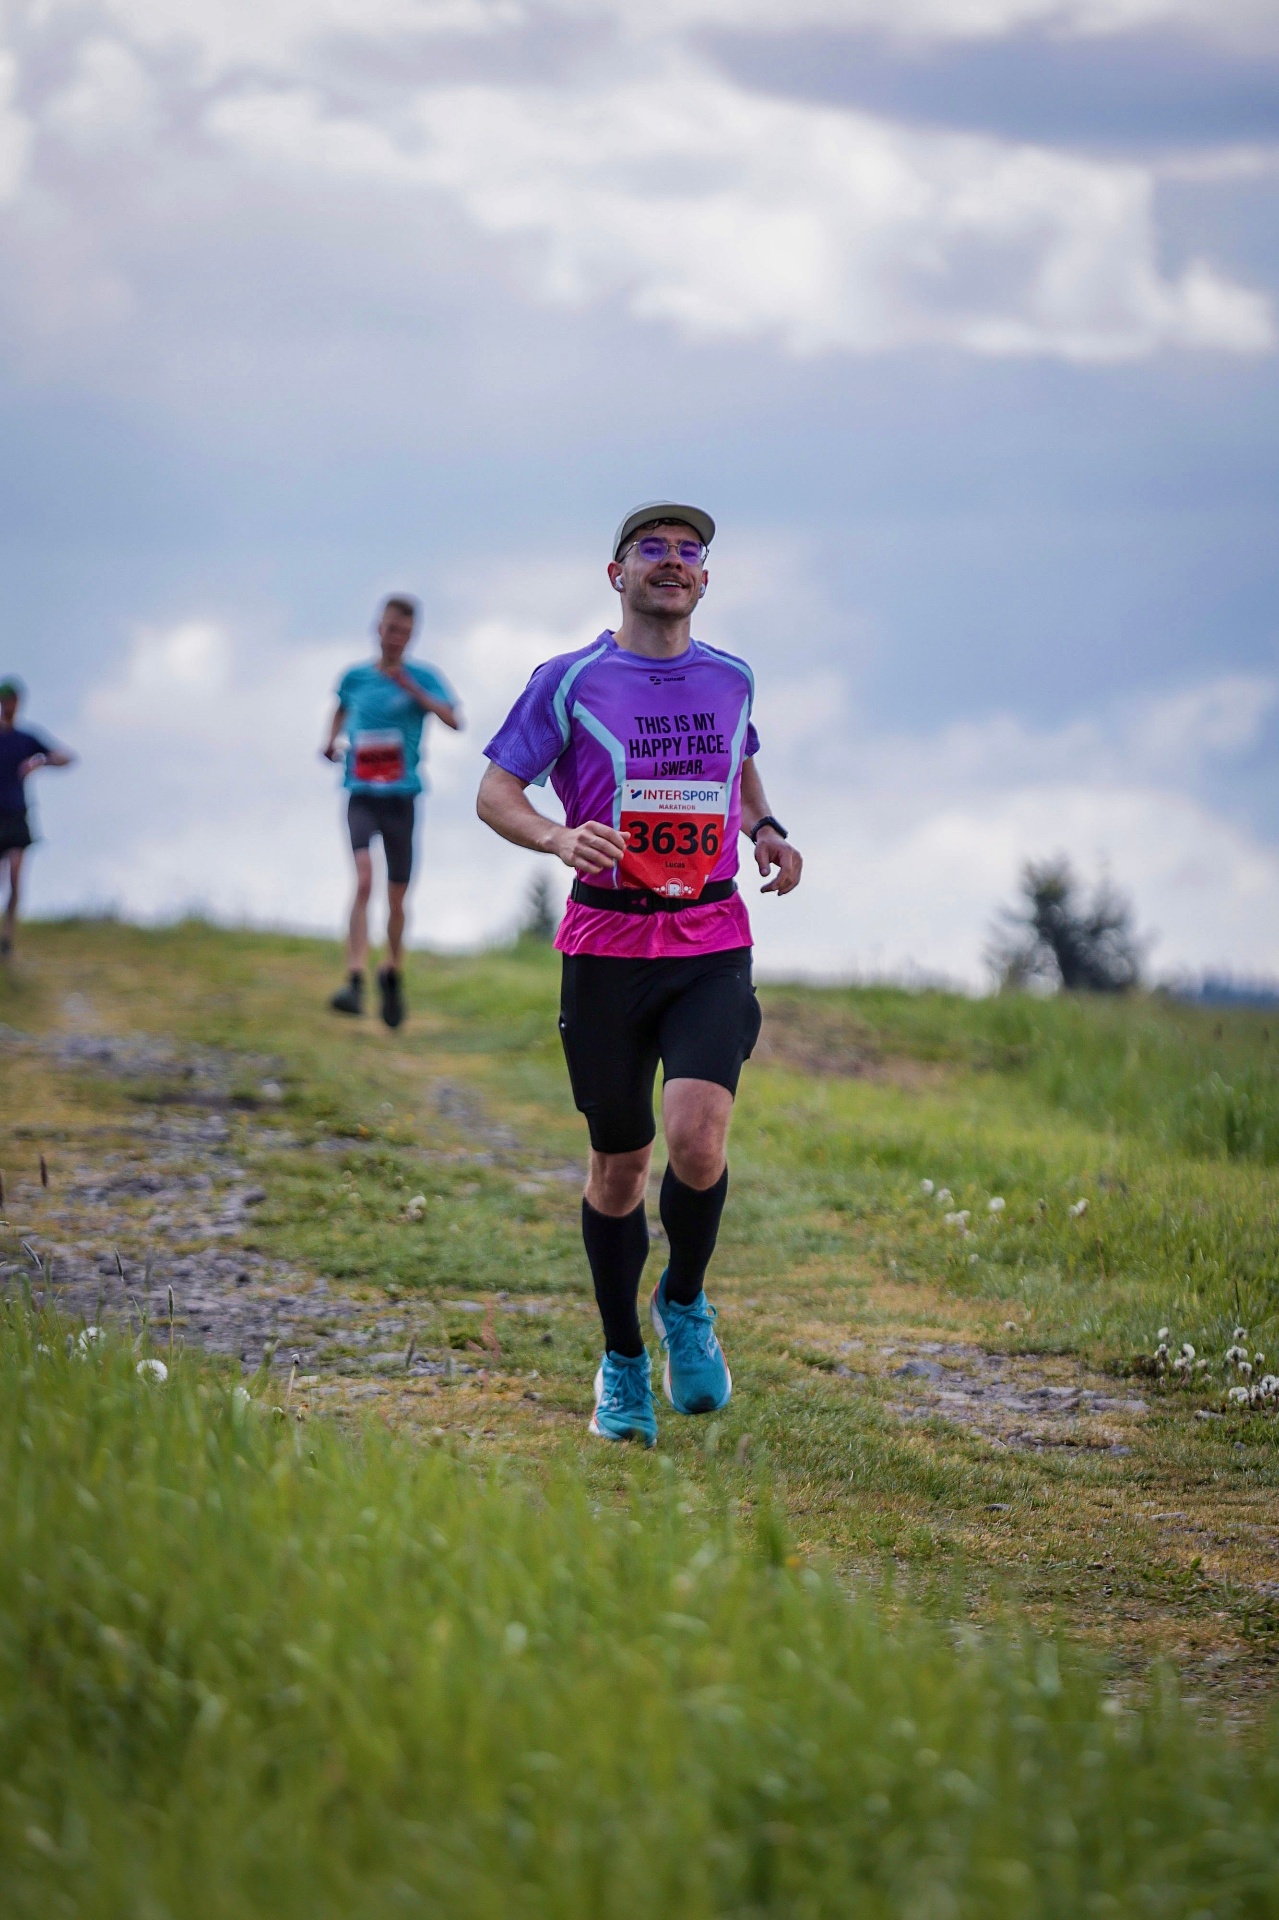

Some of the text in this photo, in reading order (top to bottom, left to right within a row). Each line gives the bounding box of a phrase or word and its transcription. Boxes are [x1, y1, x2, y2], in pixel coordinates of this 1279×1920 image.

[634, 712, 715, 734] THIS IS MY
[628, 734, 729, 759] HAPPY FACE.
[653, 759, 706, 777] I SWEAR.
[643, 789, 720, 802] INTERSPORT
[658, 803, 696, 811] MARATHON
[626, 820, 719, 857] 3636
